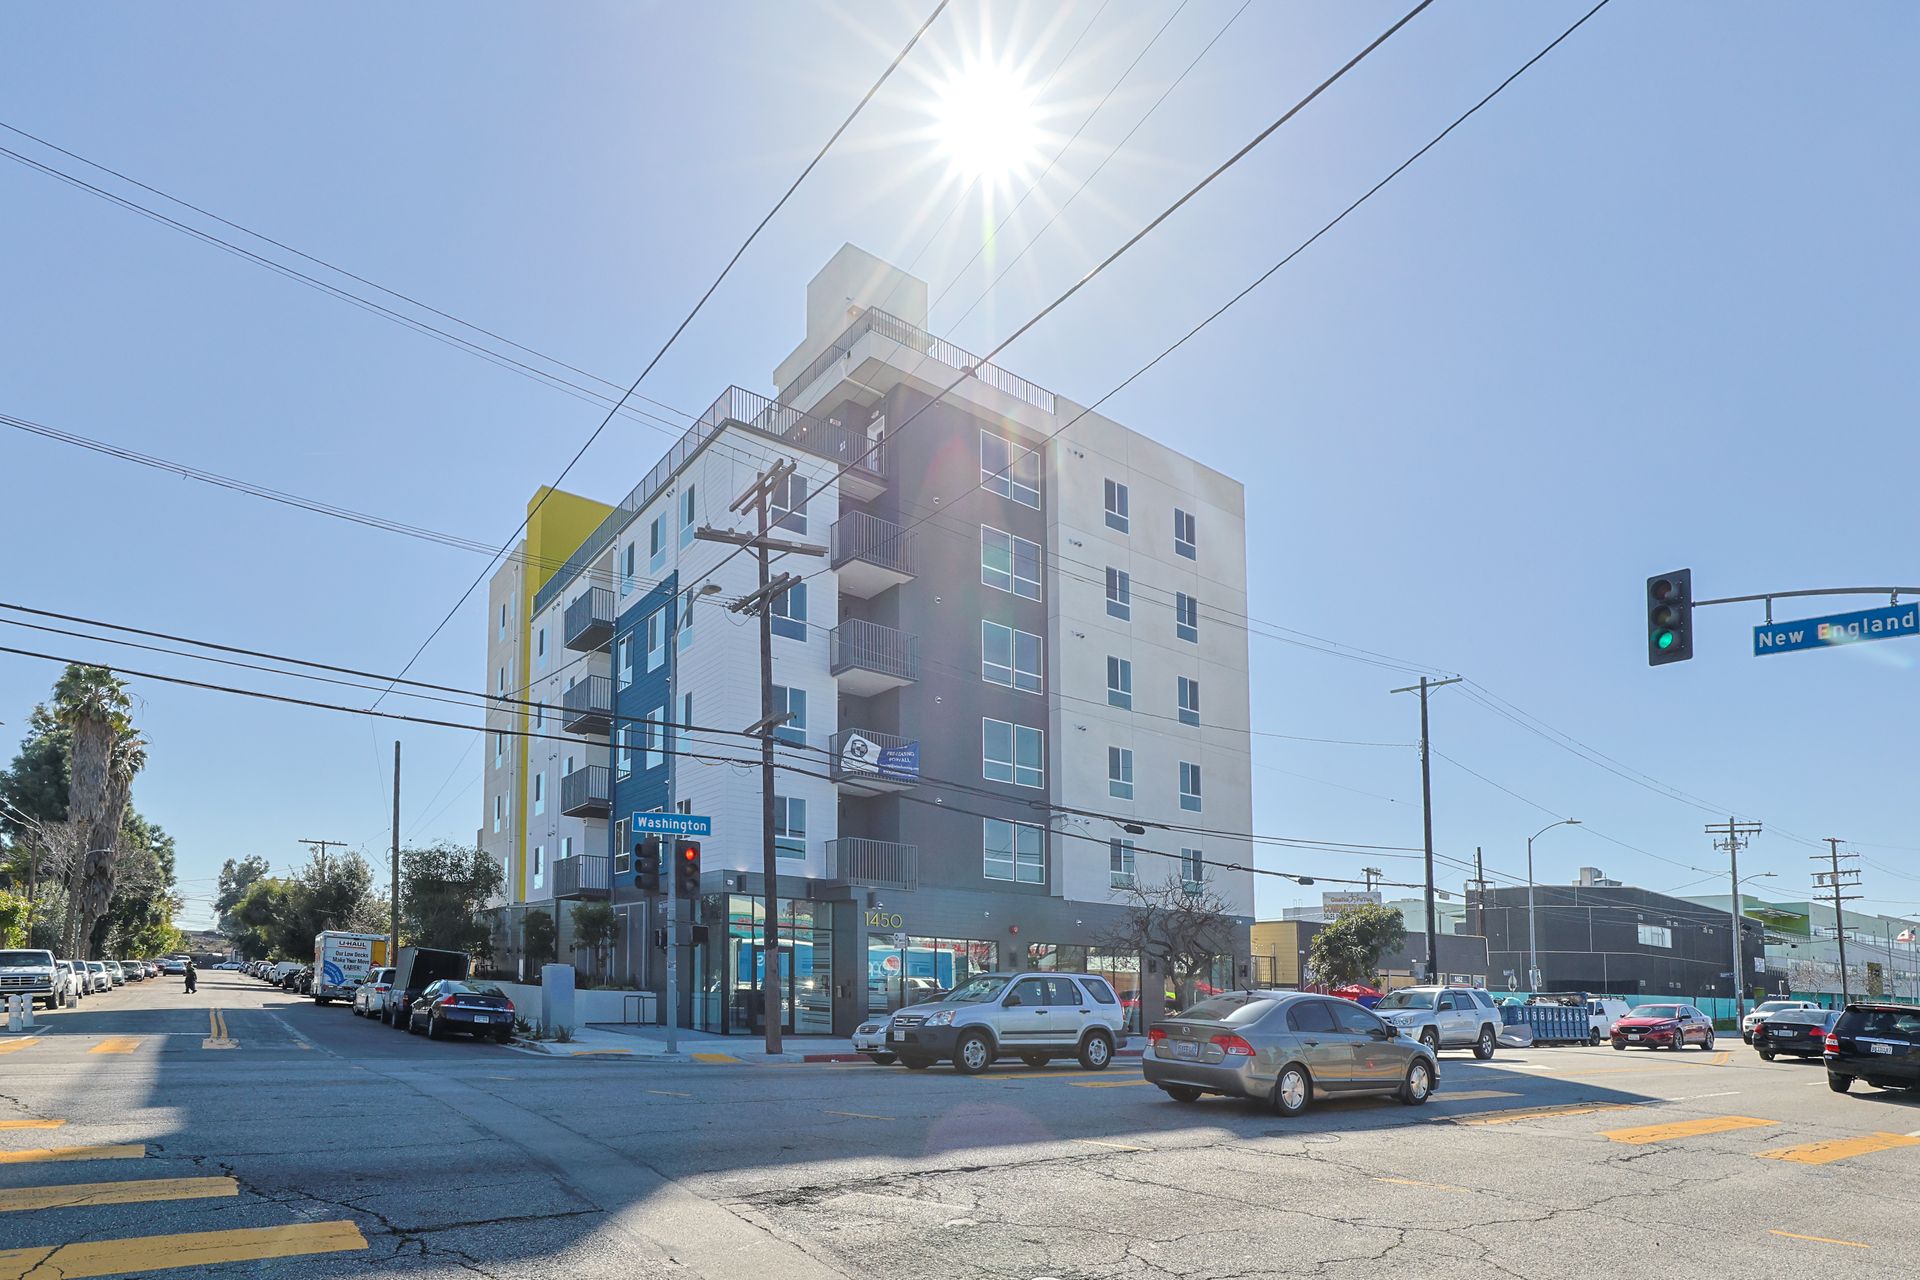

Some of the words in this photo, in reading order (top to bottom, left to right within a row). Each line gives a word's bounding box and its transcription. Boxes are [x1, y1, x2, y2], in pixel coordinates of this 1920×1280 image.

[1759, 631, 1804, 648] New
[1817, 611, 1915, 641] England
[637, 816, 707, 833] Washington
[864, 911, 903, 929] 1450
